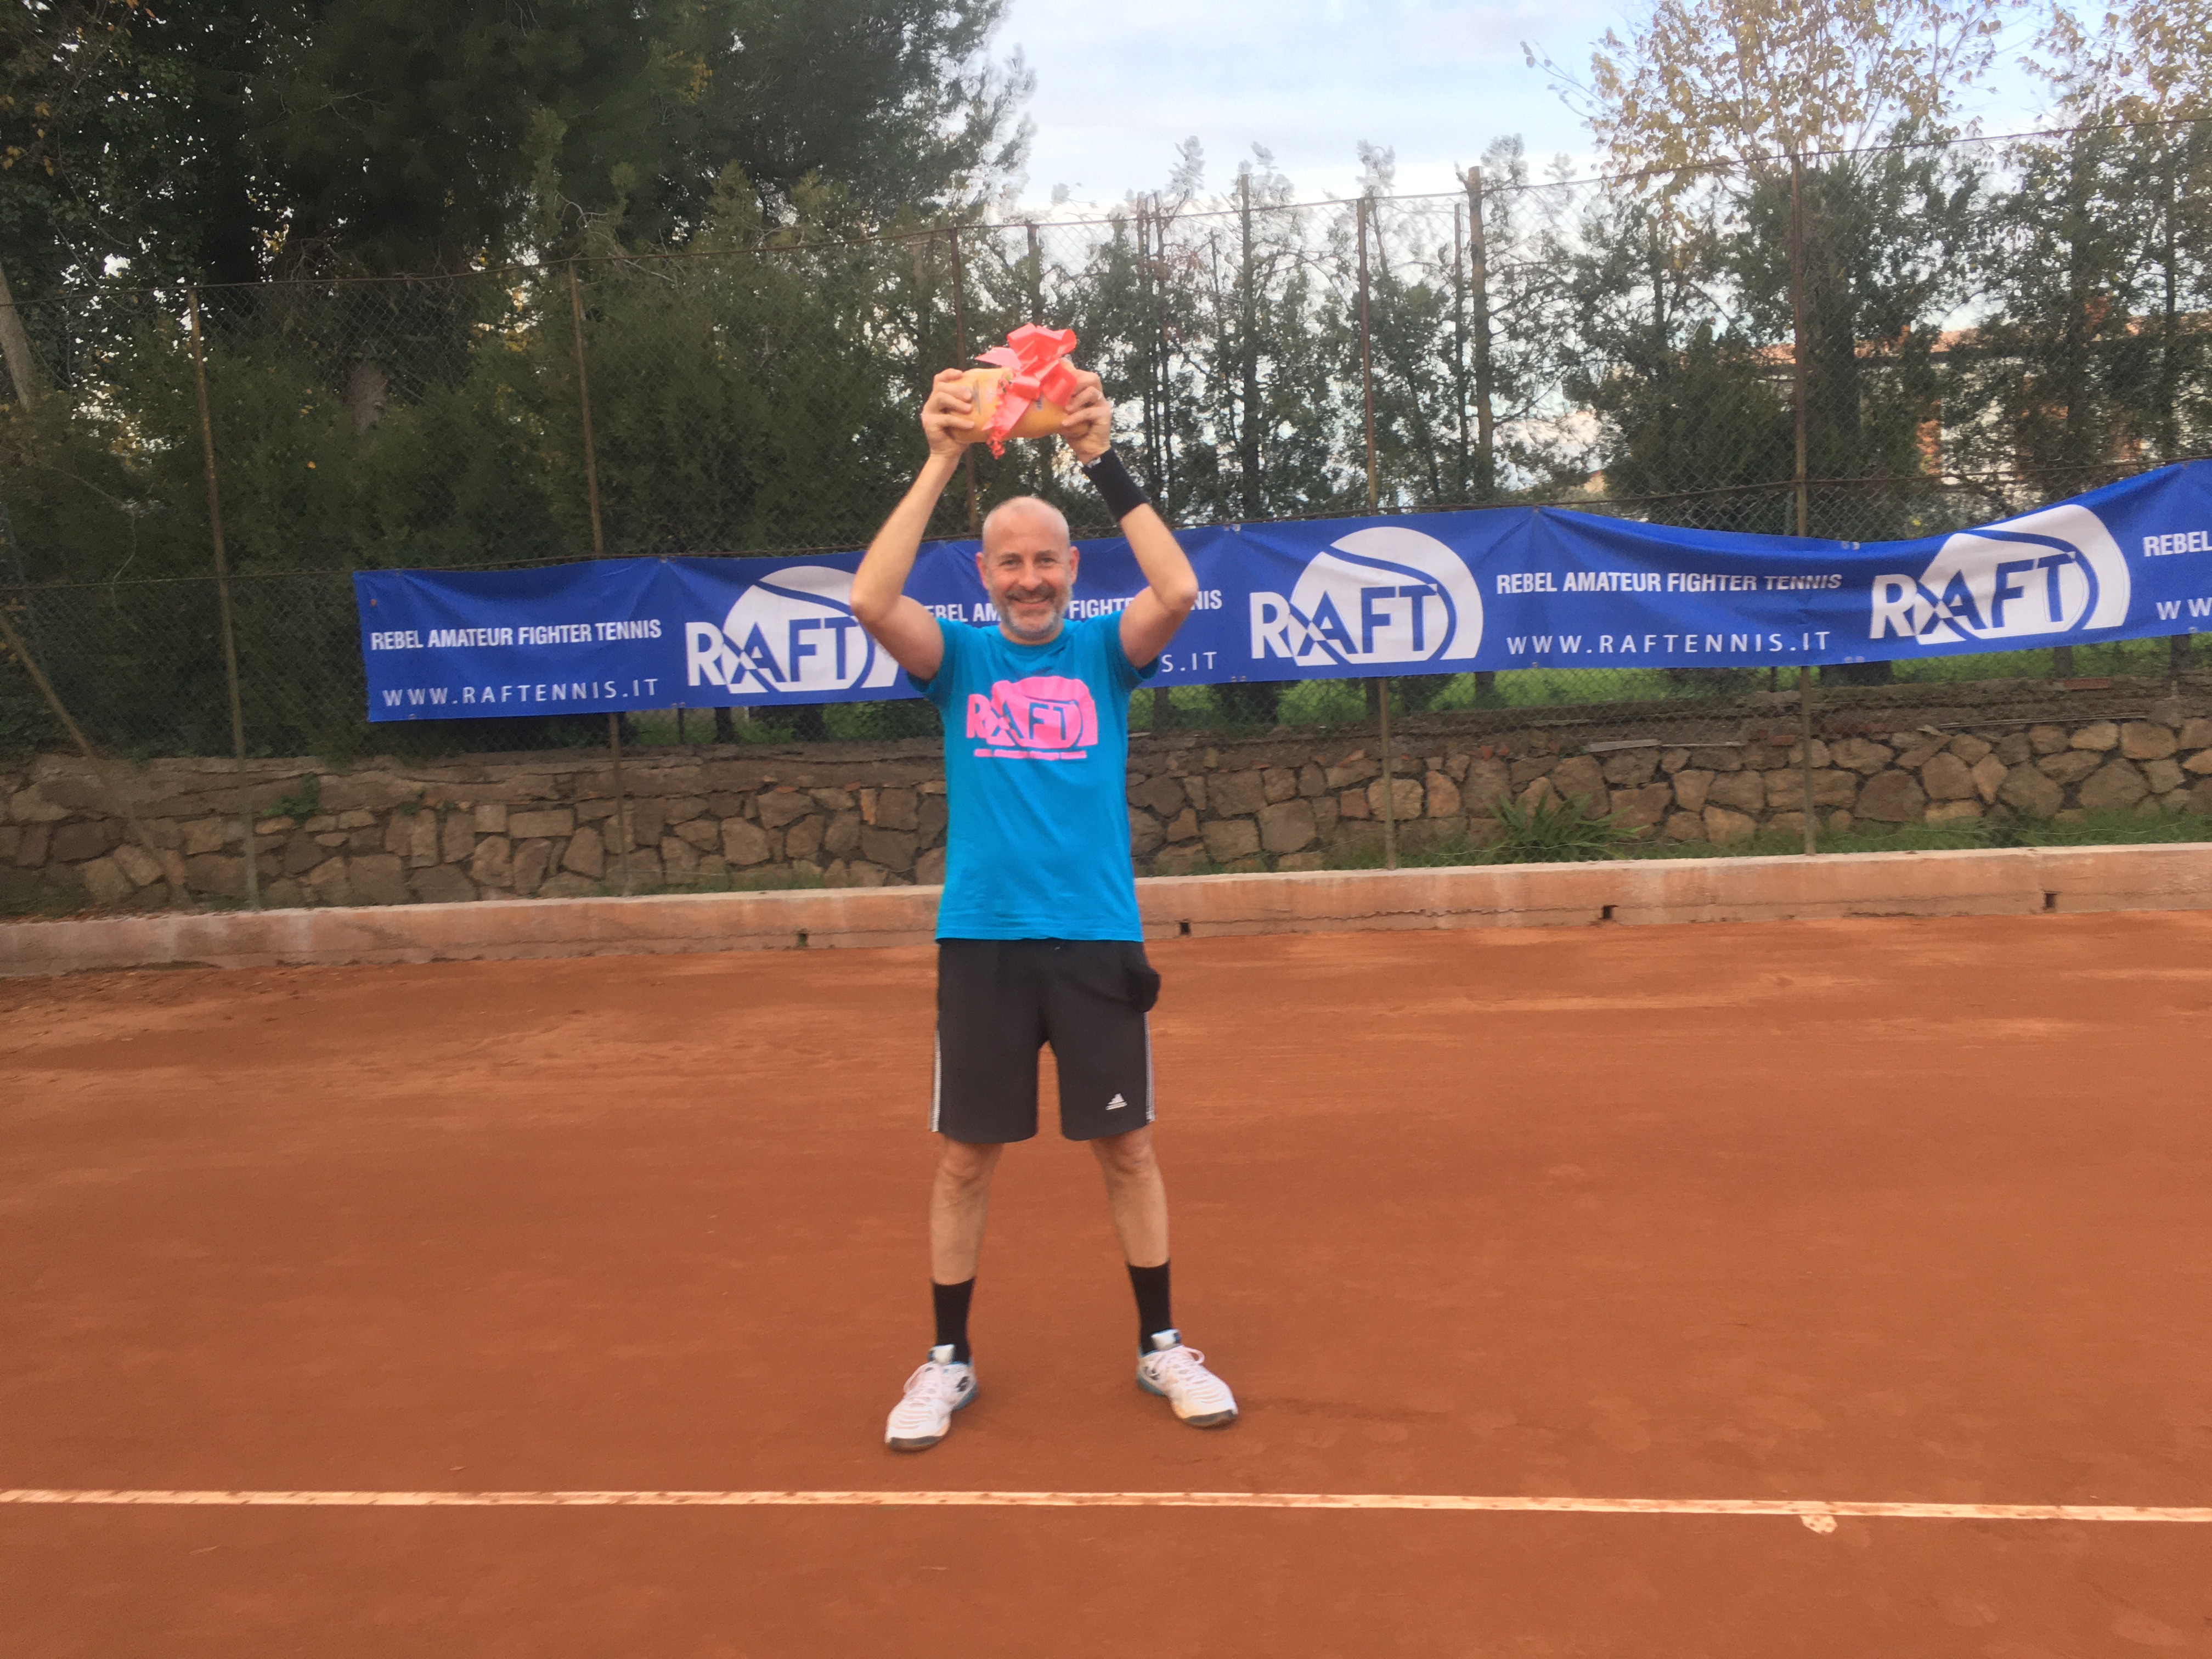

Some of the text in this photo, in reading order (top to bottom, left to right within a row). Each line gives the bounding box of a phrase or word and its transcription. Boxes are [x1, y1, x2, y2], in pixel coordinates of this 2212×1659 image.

[2142, 531, 2212, 557] REBEL
[1496, 572, 1842, 594] REBEL AMATEUR FIGHTER TENNIS
[1869, 551, 2076, 639] RAFT
[924, 603, 968, 622] BEL
[1069, 597, 1135, 619] FIGHT
[1249, 583, 1438, 659] RAFT
[371, 619, 662, 650] REBEL AMATEUR FIGHTER TENNIS
[1506, 631, 1831, 654] WWW.RAFTENNIS.IT
[685, 615, 860, 686] RAFT
[382, 679, 659, 706] WWW.RAFTENNIS.IT
[966, 693, 1066, 740] RAFT
